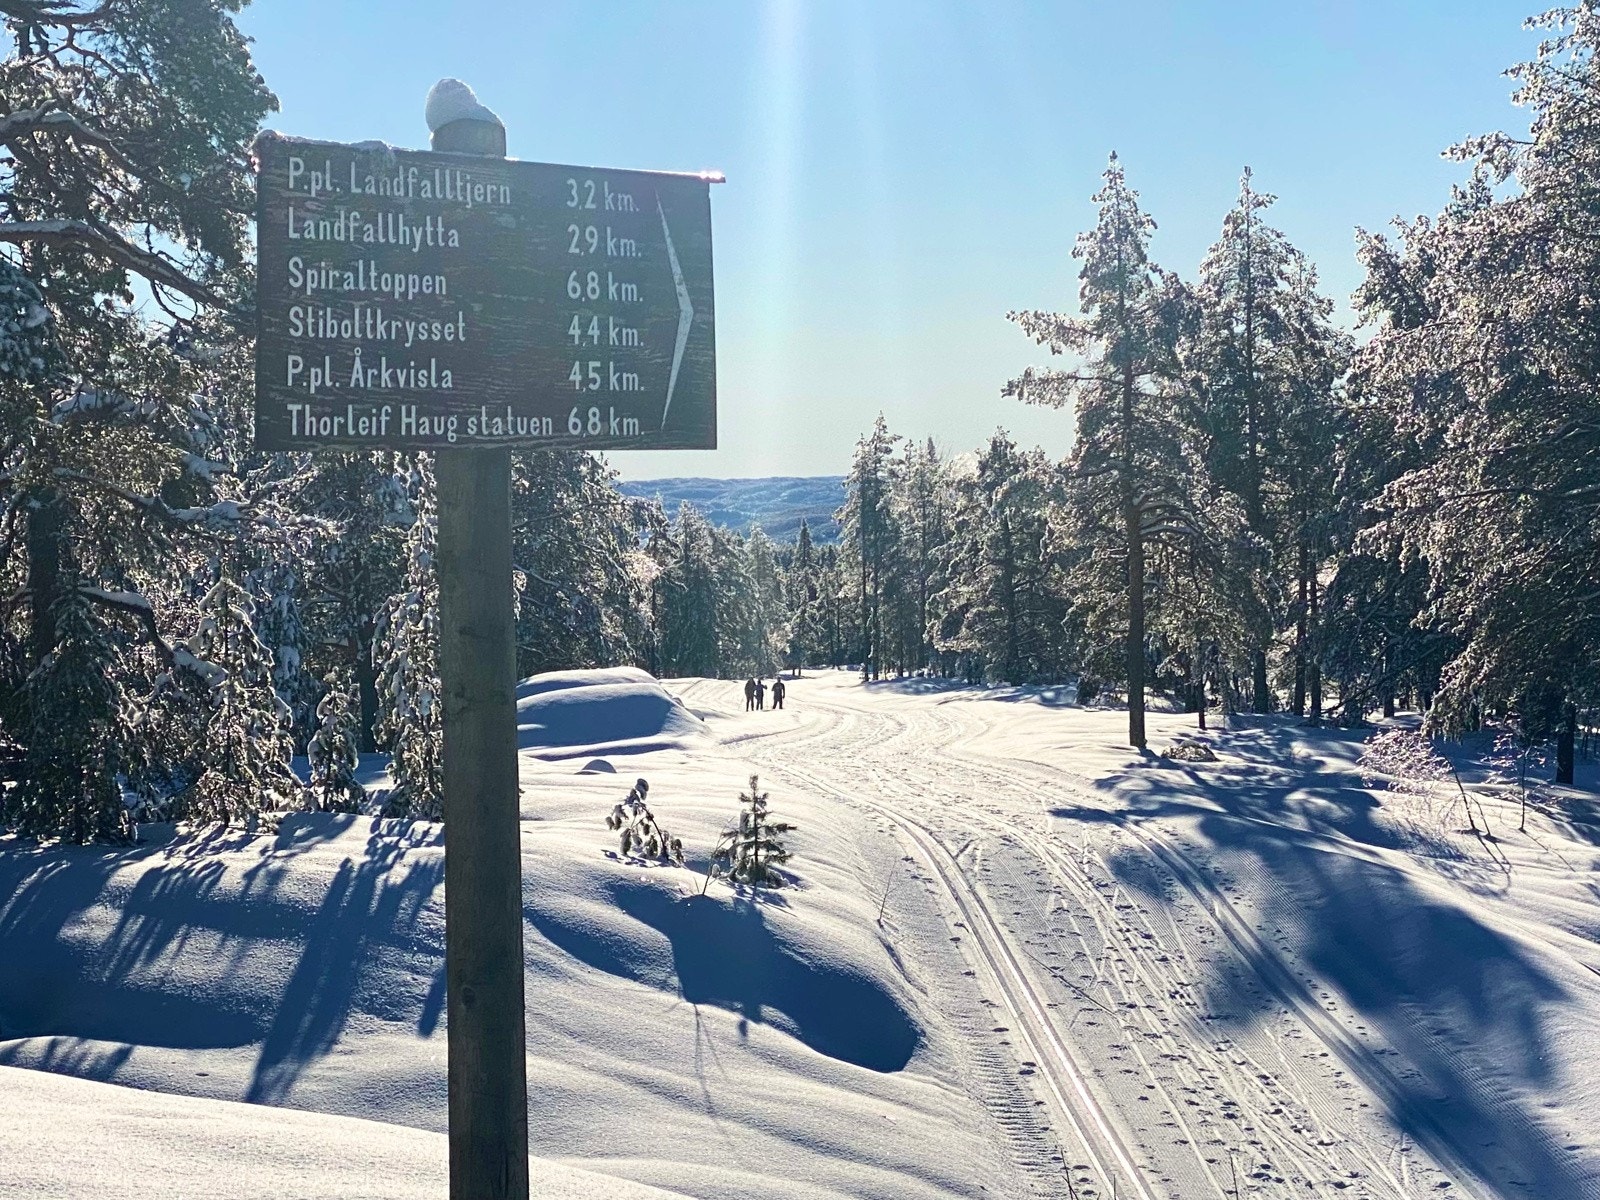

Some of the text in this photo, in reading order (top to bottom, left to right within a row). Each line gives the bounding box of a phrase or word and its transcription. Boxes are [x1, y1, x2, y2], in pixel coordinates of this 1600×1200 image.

[350, 161, 511, 208] Landfalltjern
[603, 181, 640, 212] km.
[288, 206, 642, 258] Landfallhytta 2,9 km.
[288, 256, 644, 302] Spiraltoppen 6,8 km.
[288, 306, 645, 347] Stiboltkrysset 4,4 km.
[350, 347, 454, 388] Årkvisla
[568, 360, 602, 392] 4,5
[609, 361, 646, 391] km.
[286, 404, 646, 443] Thorleif Haug statuen 6,8 km.
